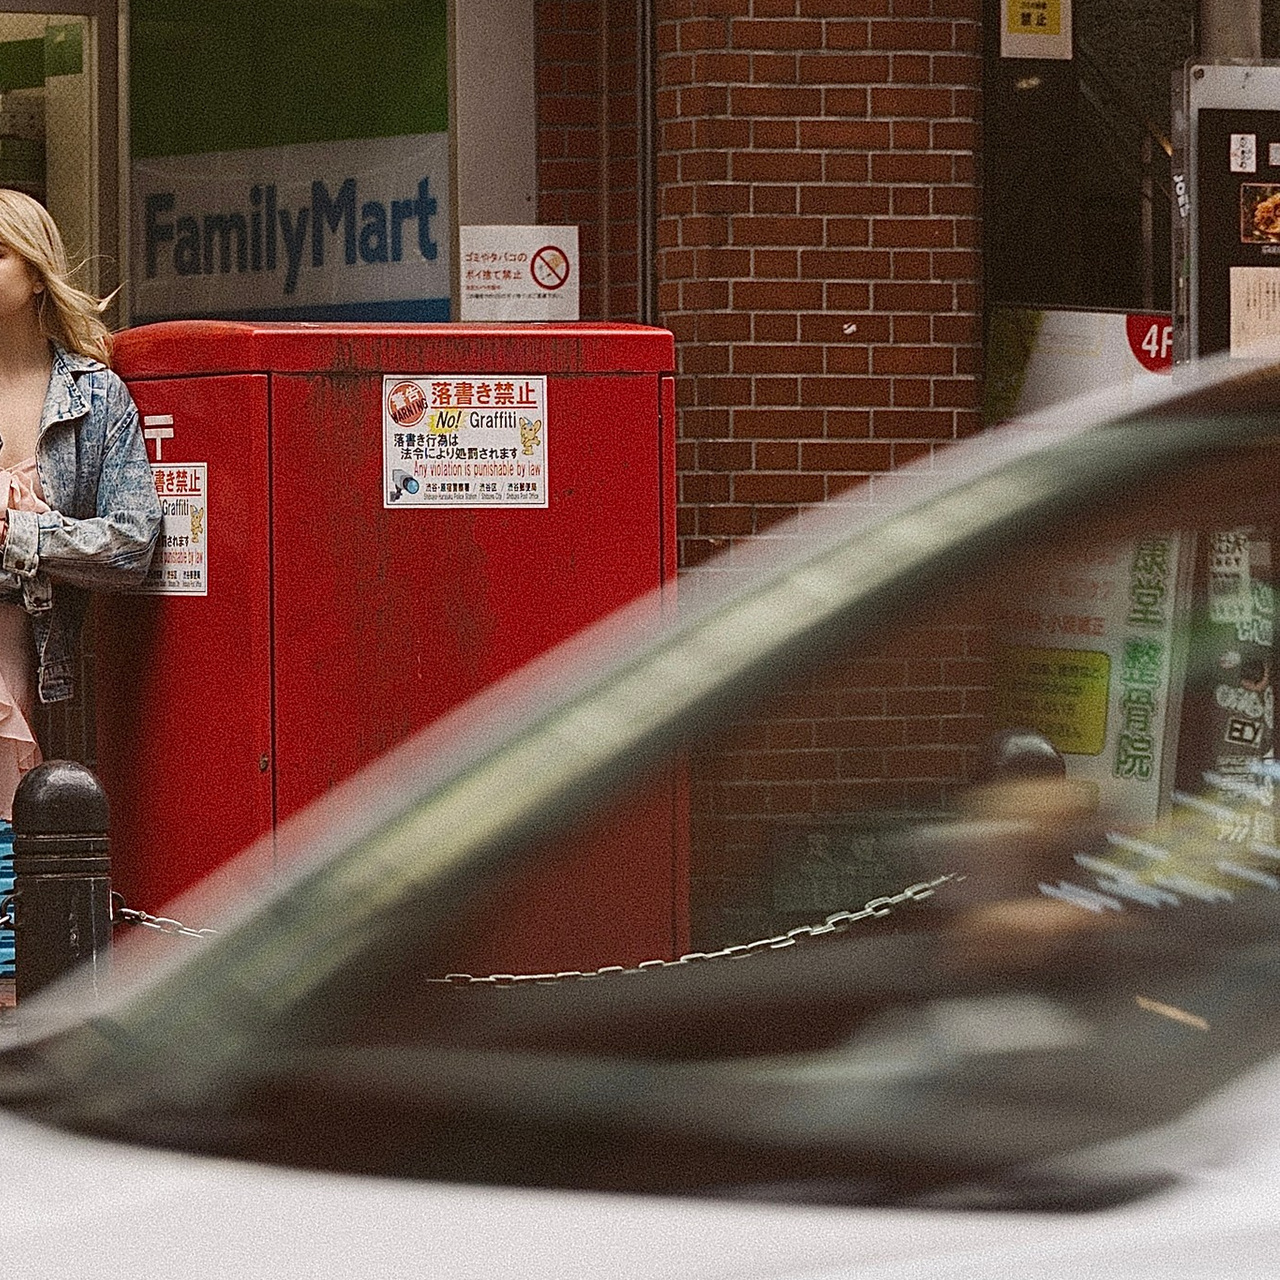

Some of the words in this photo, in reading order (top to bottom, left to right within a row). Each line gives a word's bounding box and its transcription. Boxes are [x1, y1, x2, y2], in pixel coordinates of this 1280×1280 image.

[143, 174, 439, 295] FamilyMart
[431, 382, 537, 405] 落書き禁止
[391, 398, 429, 424] WARNING
[436, 411, 462, 430] No!
[470, 411, 516, 429] Graffiti
[394, 434, 459, 447] 落書き行為は
[400, 448, 518, 460] 法令により処罰されます
[414, 461, 428, 477] Any
[430, 461, 462, 476] violation
[464, 461, 471, 476] is
[474, 461, 513, 477] punishable
[517, 461, 526, 477] by
[528, 461, 541, 476] law
[152, 469, 201, 493] 書き禁止
[162, 498, 189, 517] Graffiti
